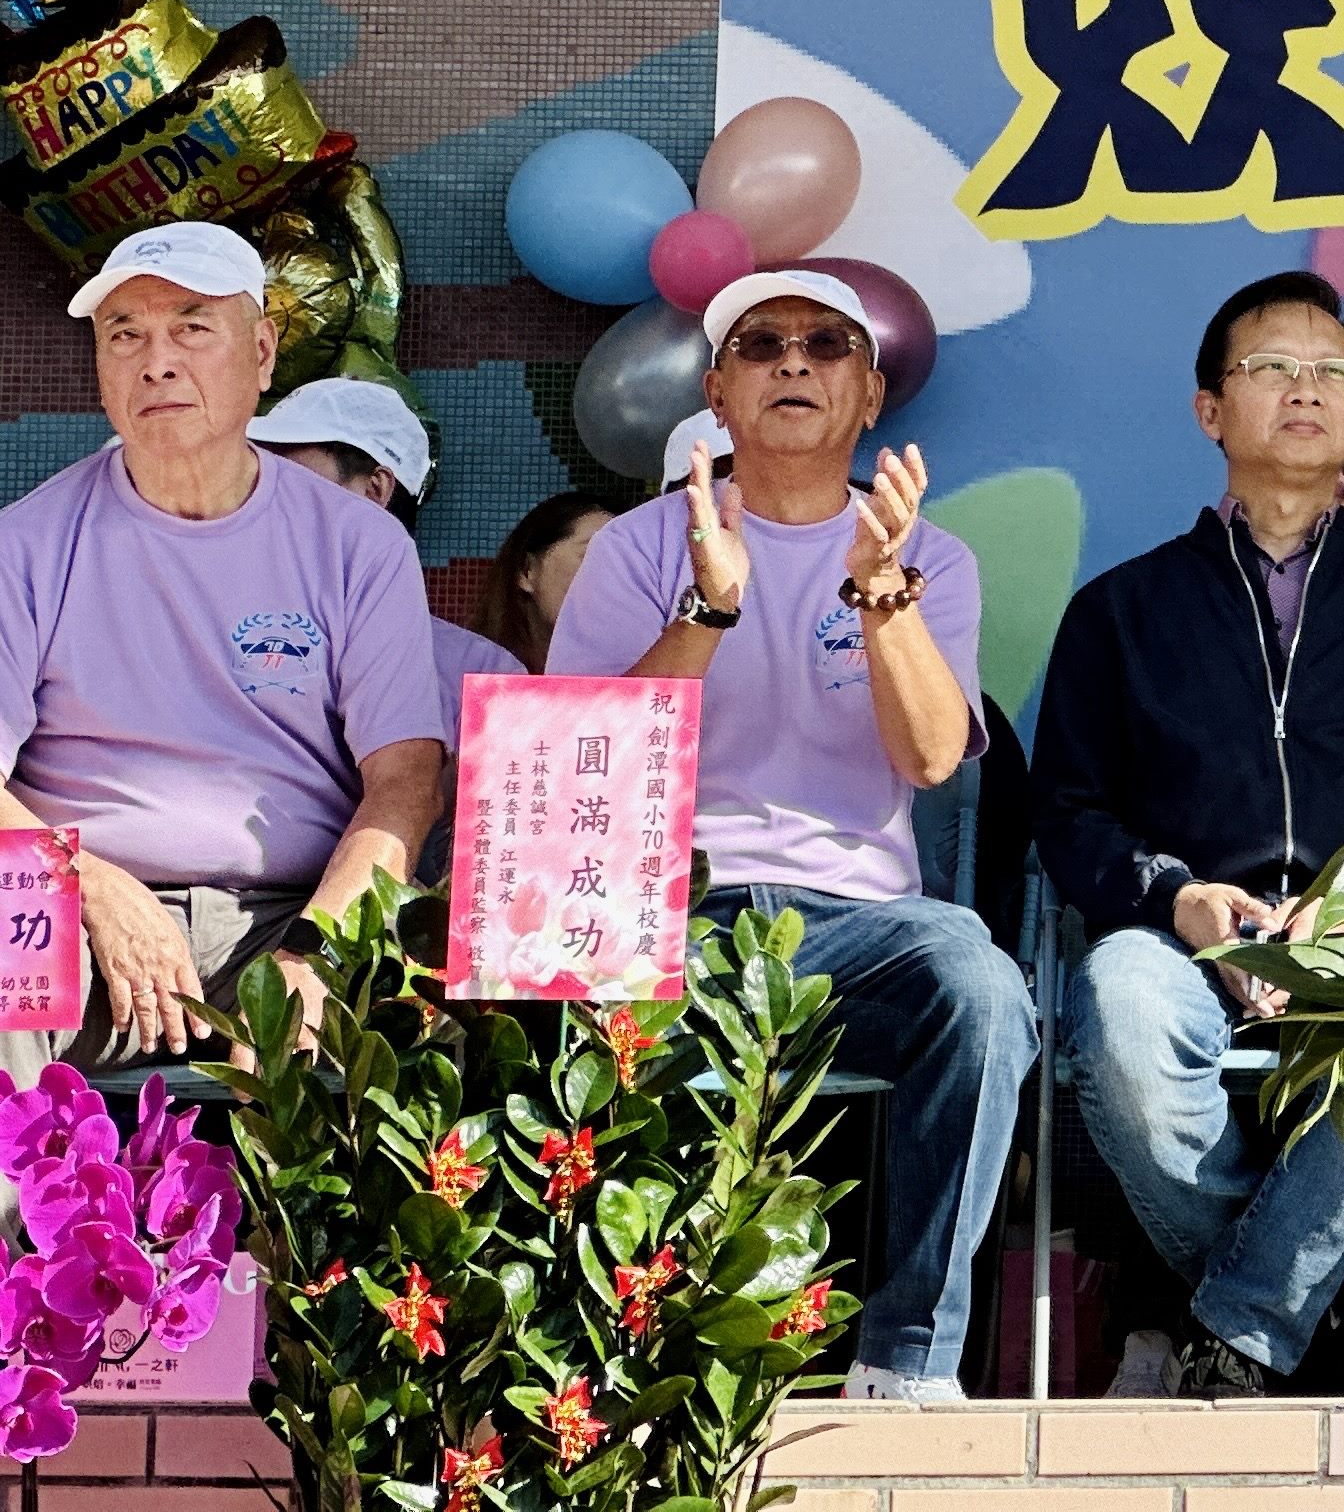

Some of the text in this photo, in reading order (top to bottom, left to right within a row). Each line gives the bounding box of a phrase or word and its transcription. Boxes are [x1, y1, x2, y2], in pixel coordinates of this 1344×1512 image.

[22, 46, 165, 163] HAPPY
[497, 760, 522, 904] 主任委員 江運永
[562, 735, 611, 959] 圓滿成功
[633, 692, 676, 957] 祝 劍潭國小70週年校慶
[9, 909, 52, 951] 功
[2, 975, 49, 991] 幼兒園
[18, 995, 51, 1012] 敬賀
[135, 1359, 179, 1373] 一之軒
